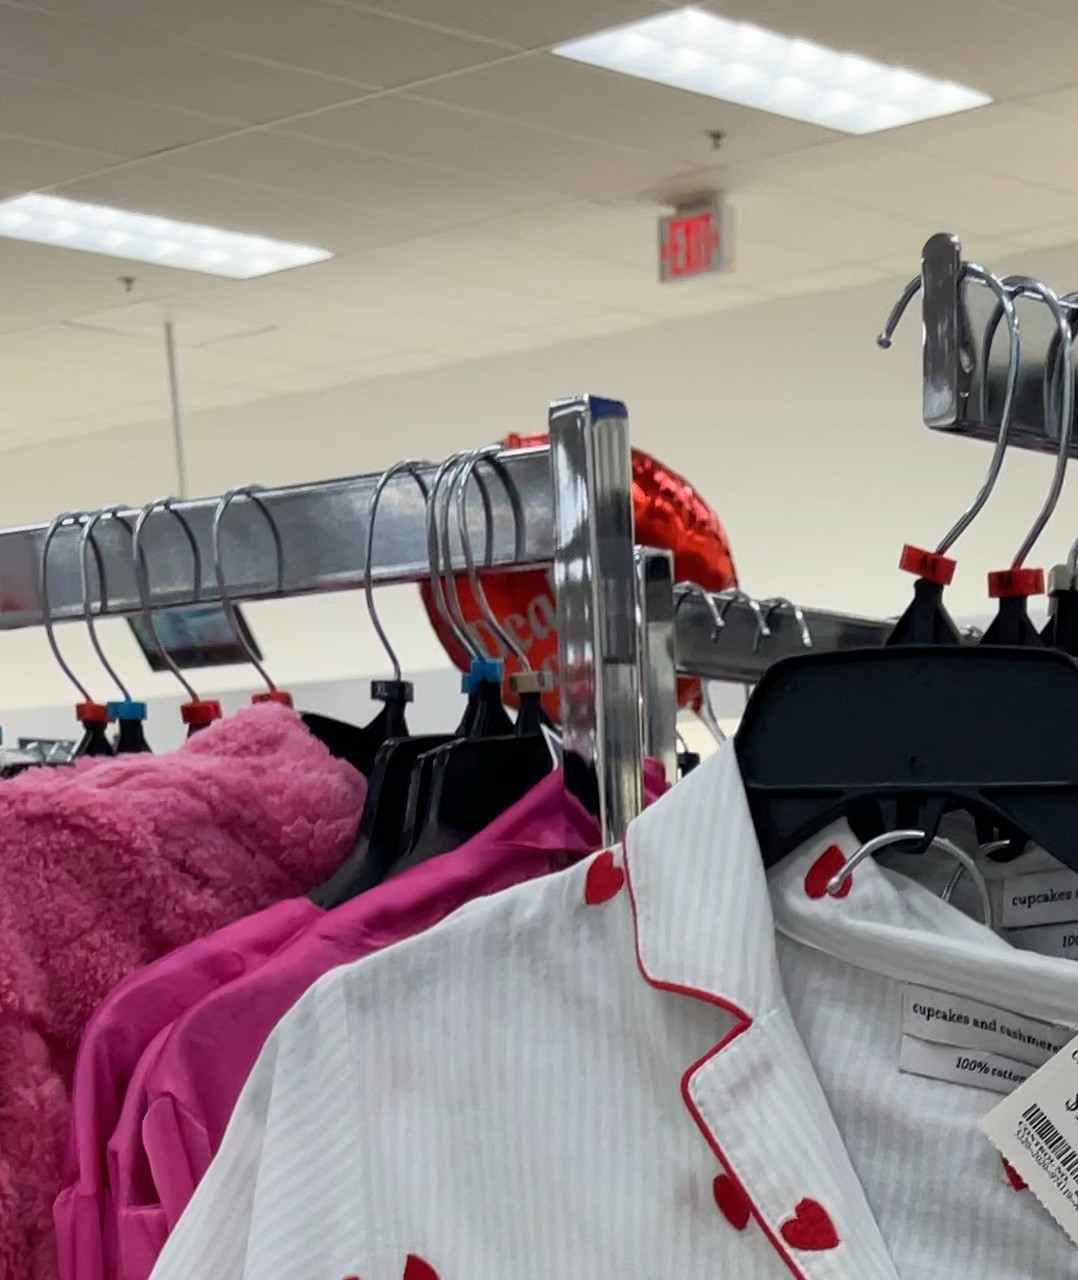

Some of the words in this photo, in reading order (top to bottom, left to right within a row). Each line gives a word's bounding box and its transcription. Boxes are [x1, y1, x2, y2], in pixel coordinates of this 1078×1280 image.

[669, 214, 713, 277] EXIT
[1012, 888, 1072, 909] cupcakes
[912, 1002, 970, 1026] cupcakes
[972, 1016, 997, 1033] and
[956, 1056, 990, 1075] 100%
